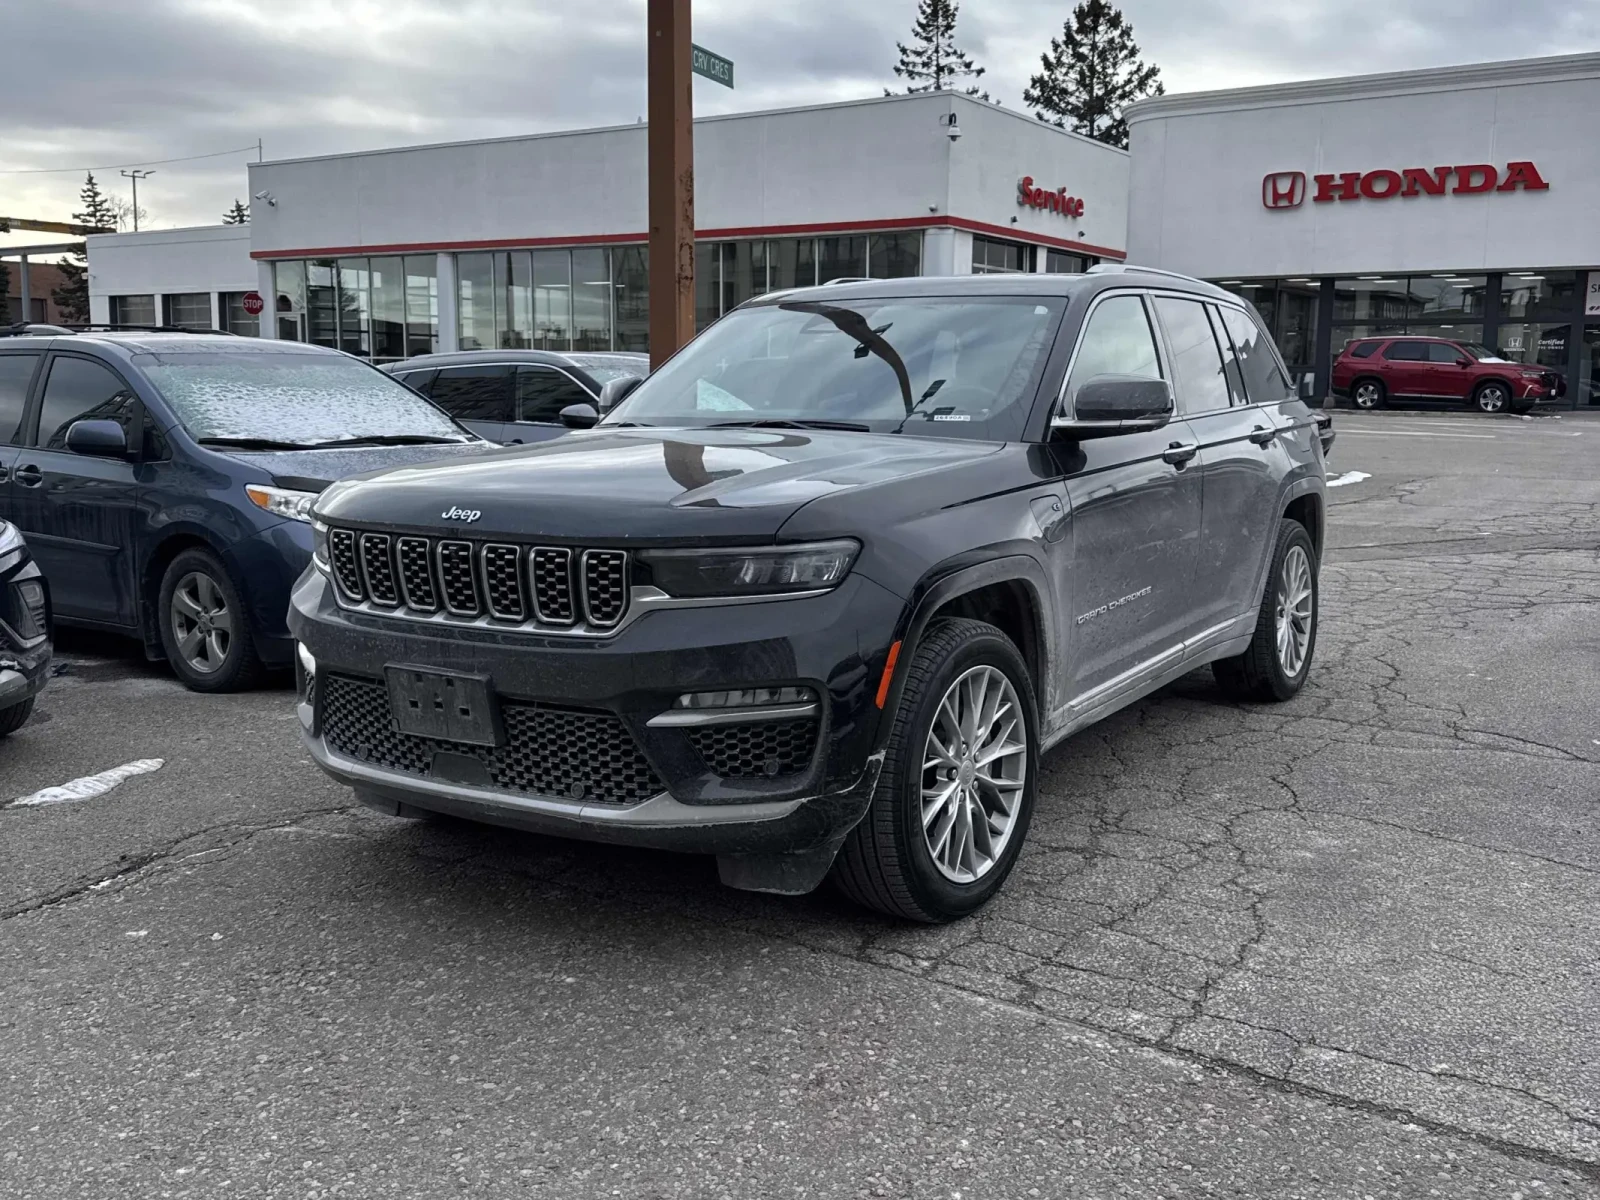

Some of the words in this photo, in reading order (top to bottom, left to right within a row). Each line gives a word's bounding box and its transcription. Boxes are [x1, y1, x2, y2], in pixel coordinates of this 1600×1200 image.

[693, 50, 708, 70] CRV
[710, 58, 729, 80] CRES
[1019, 176, 1084, 217] Service
[1313, 161, 1549, 202] HONDA
[244, 300, 262, 309] STOP
[441, 505, 481, 523] Jeep
[1077, 605, 1107, 624] GRAND
[1108, 585, 1152, 610] CHEROKEE
